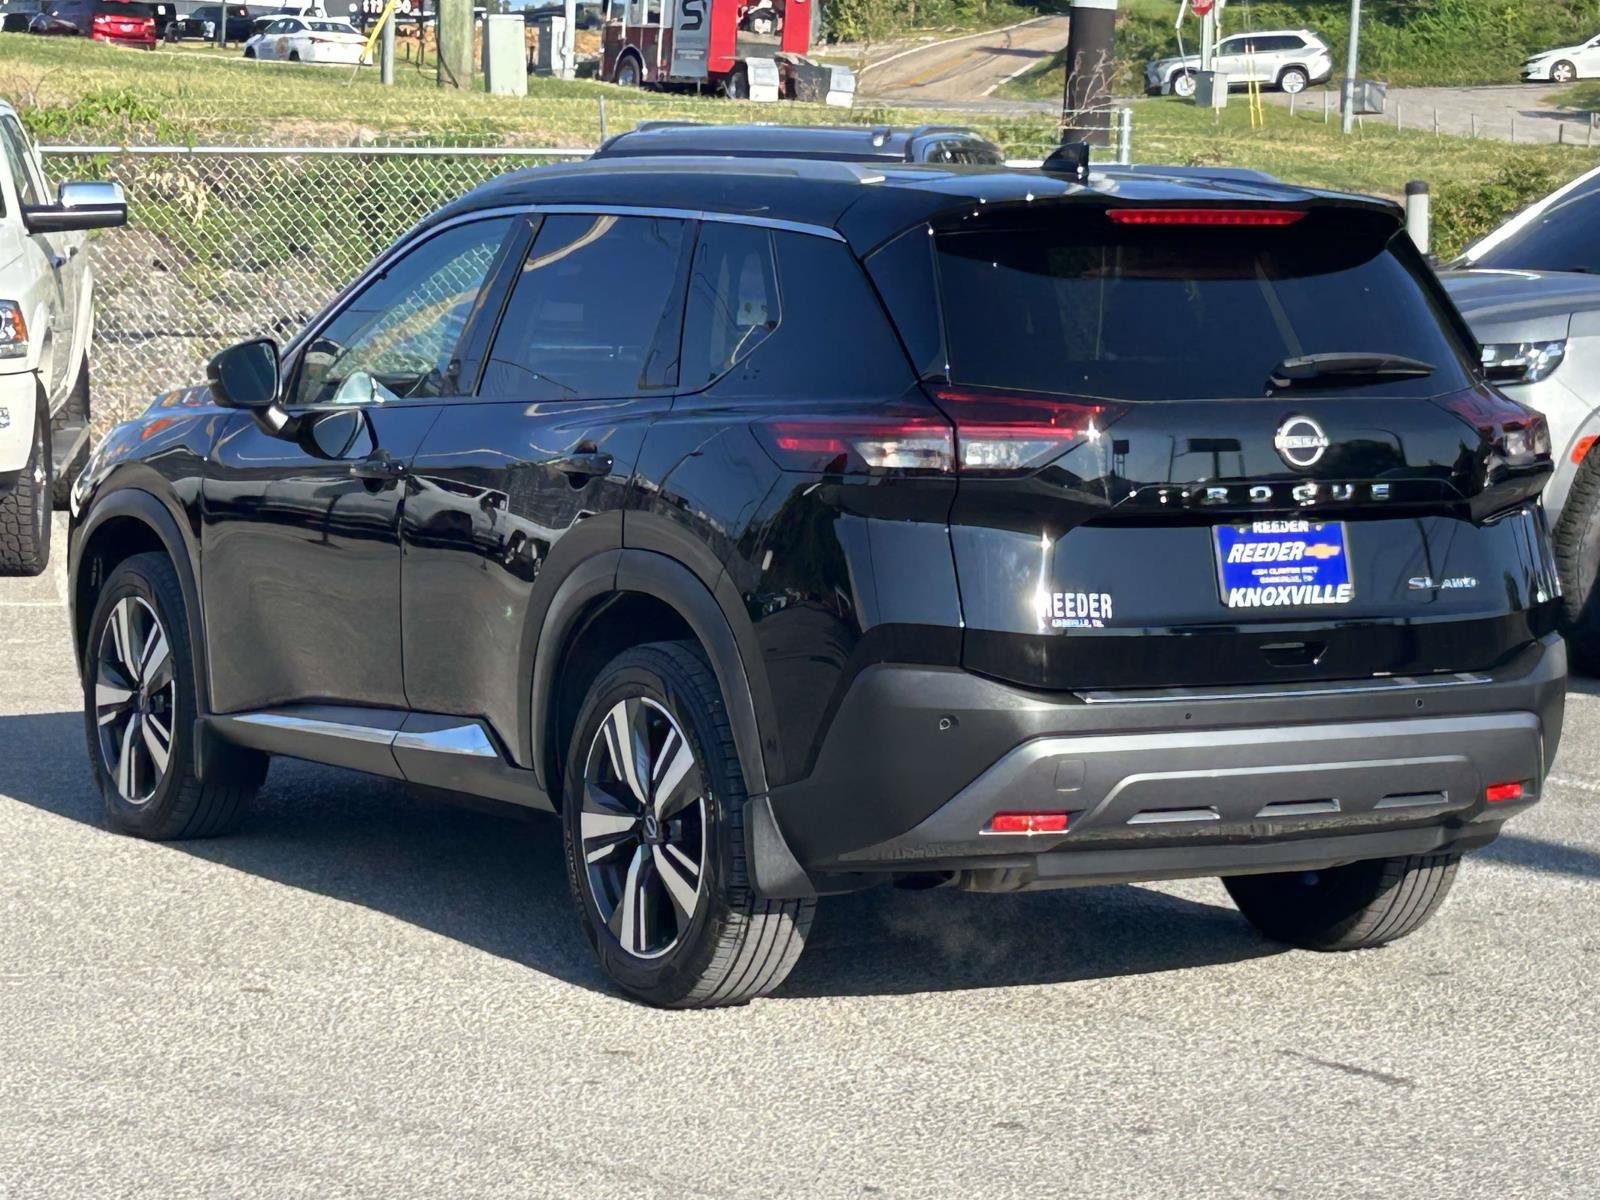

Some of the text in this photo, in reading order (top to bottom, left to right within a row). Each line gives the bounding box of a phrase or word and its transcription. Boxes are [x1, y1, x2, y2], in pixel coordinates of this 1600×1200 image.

[1206, 483, 1391, 505] ROGUE
[1252, 520, 1309, 533] REEDER
[1227, 541, 1306, 563] REEDER
[1228, 583, 1352, 608] KNOXVILLE
